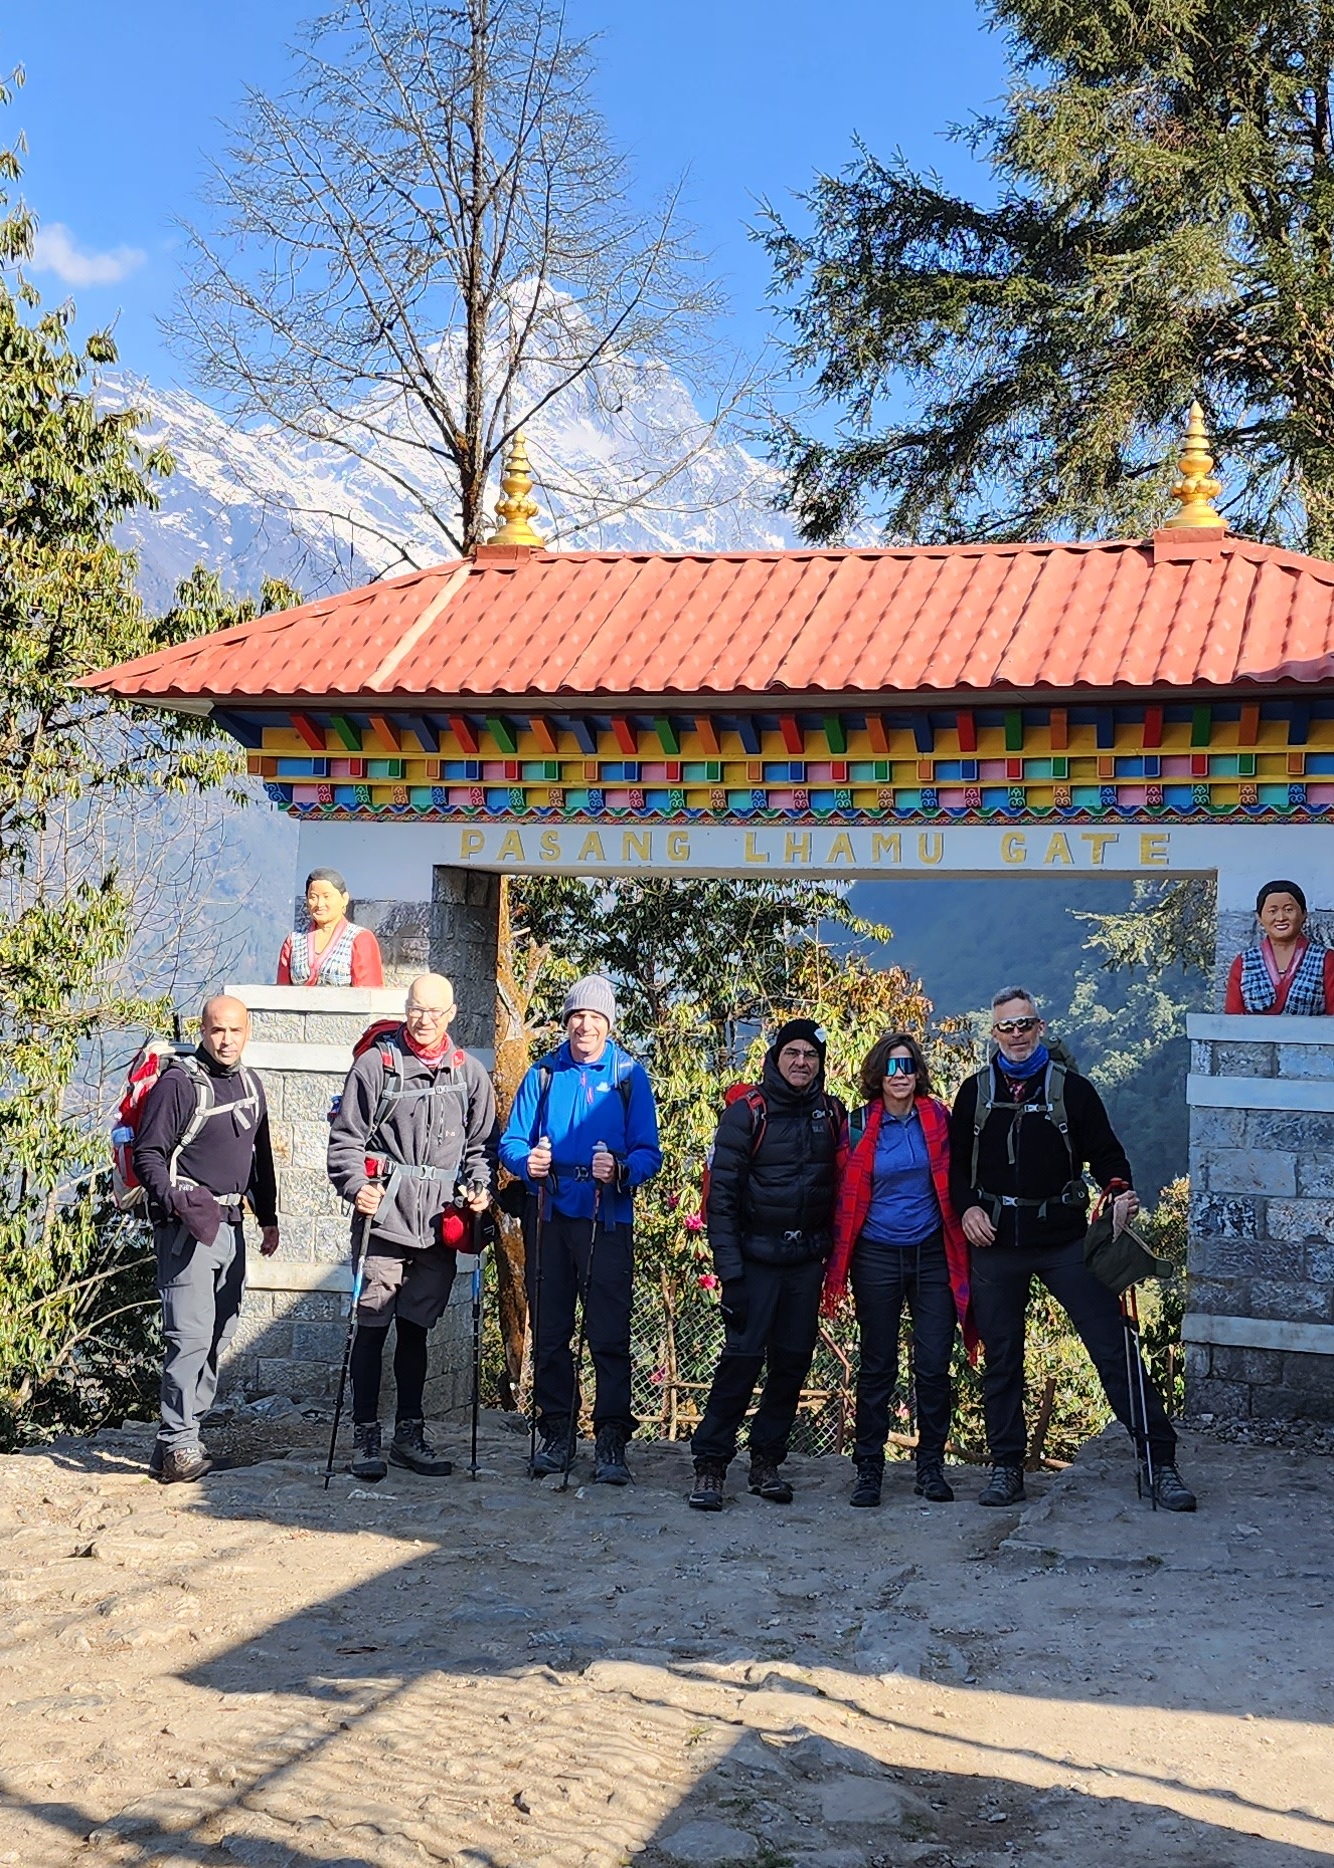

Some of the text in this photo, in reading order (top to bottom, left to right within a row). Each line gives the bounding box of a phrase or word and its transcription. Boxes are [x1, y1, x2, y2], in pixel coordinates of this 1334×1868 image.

[460, 830, 1172, 865] PASANG LHAMU GATE
